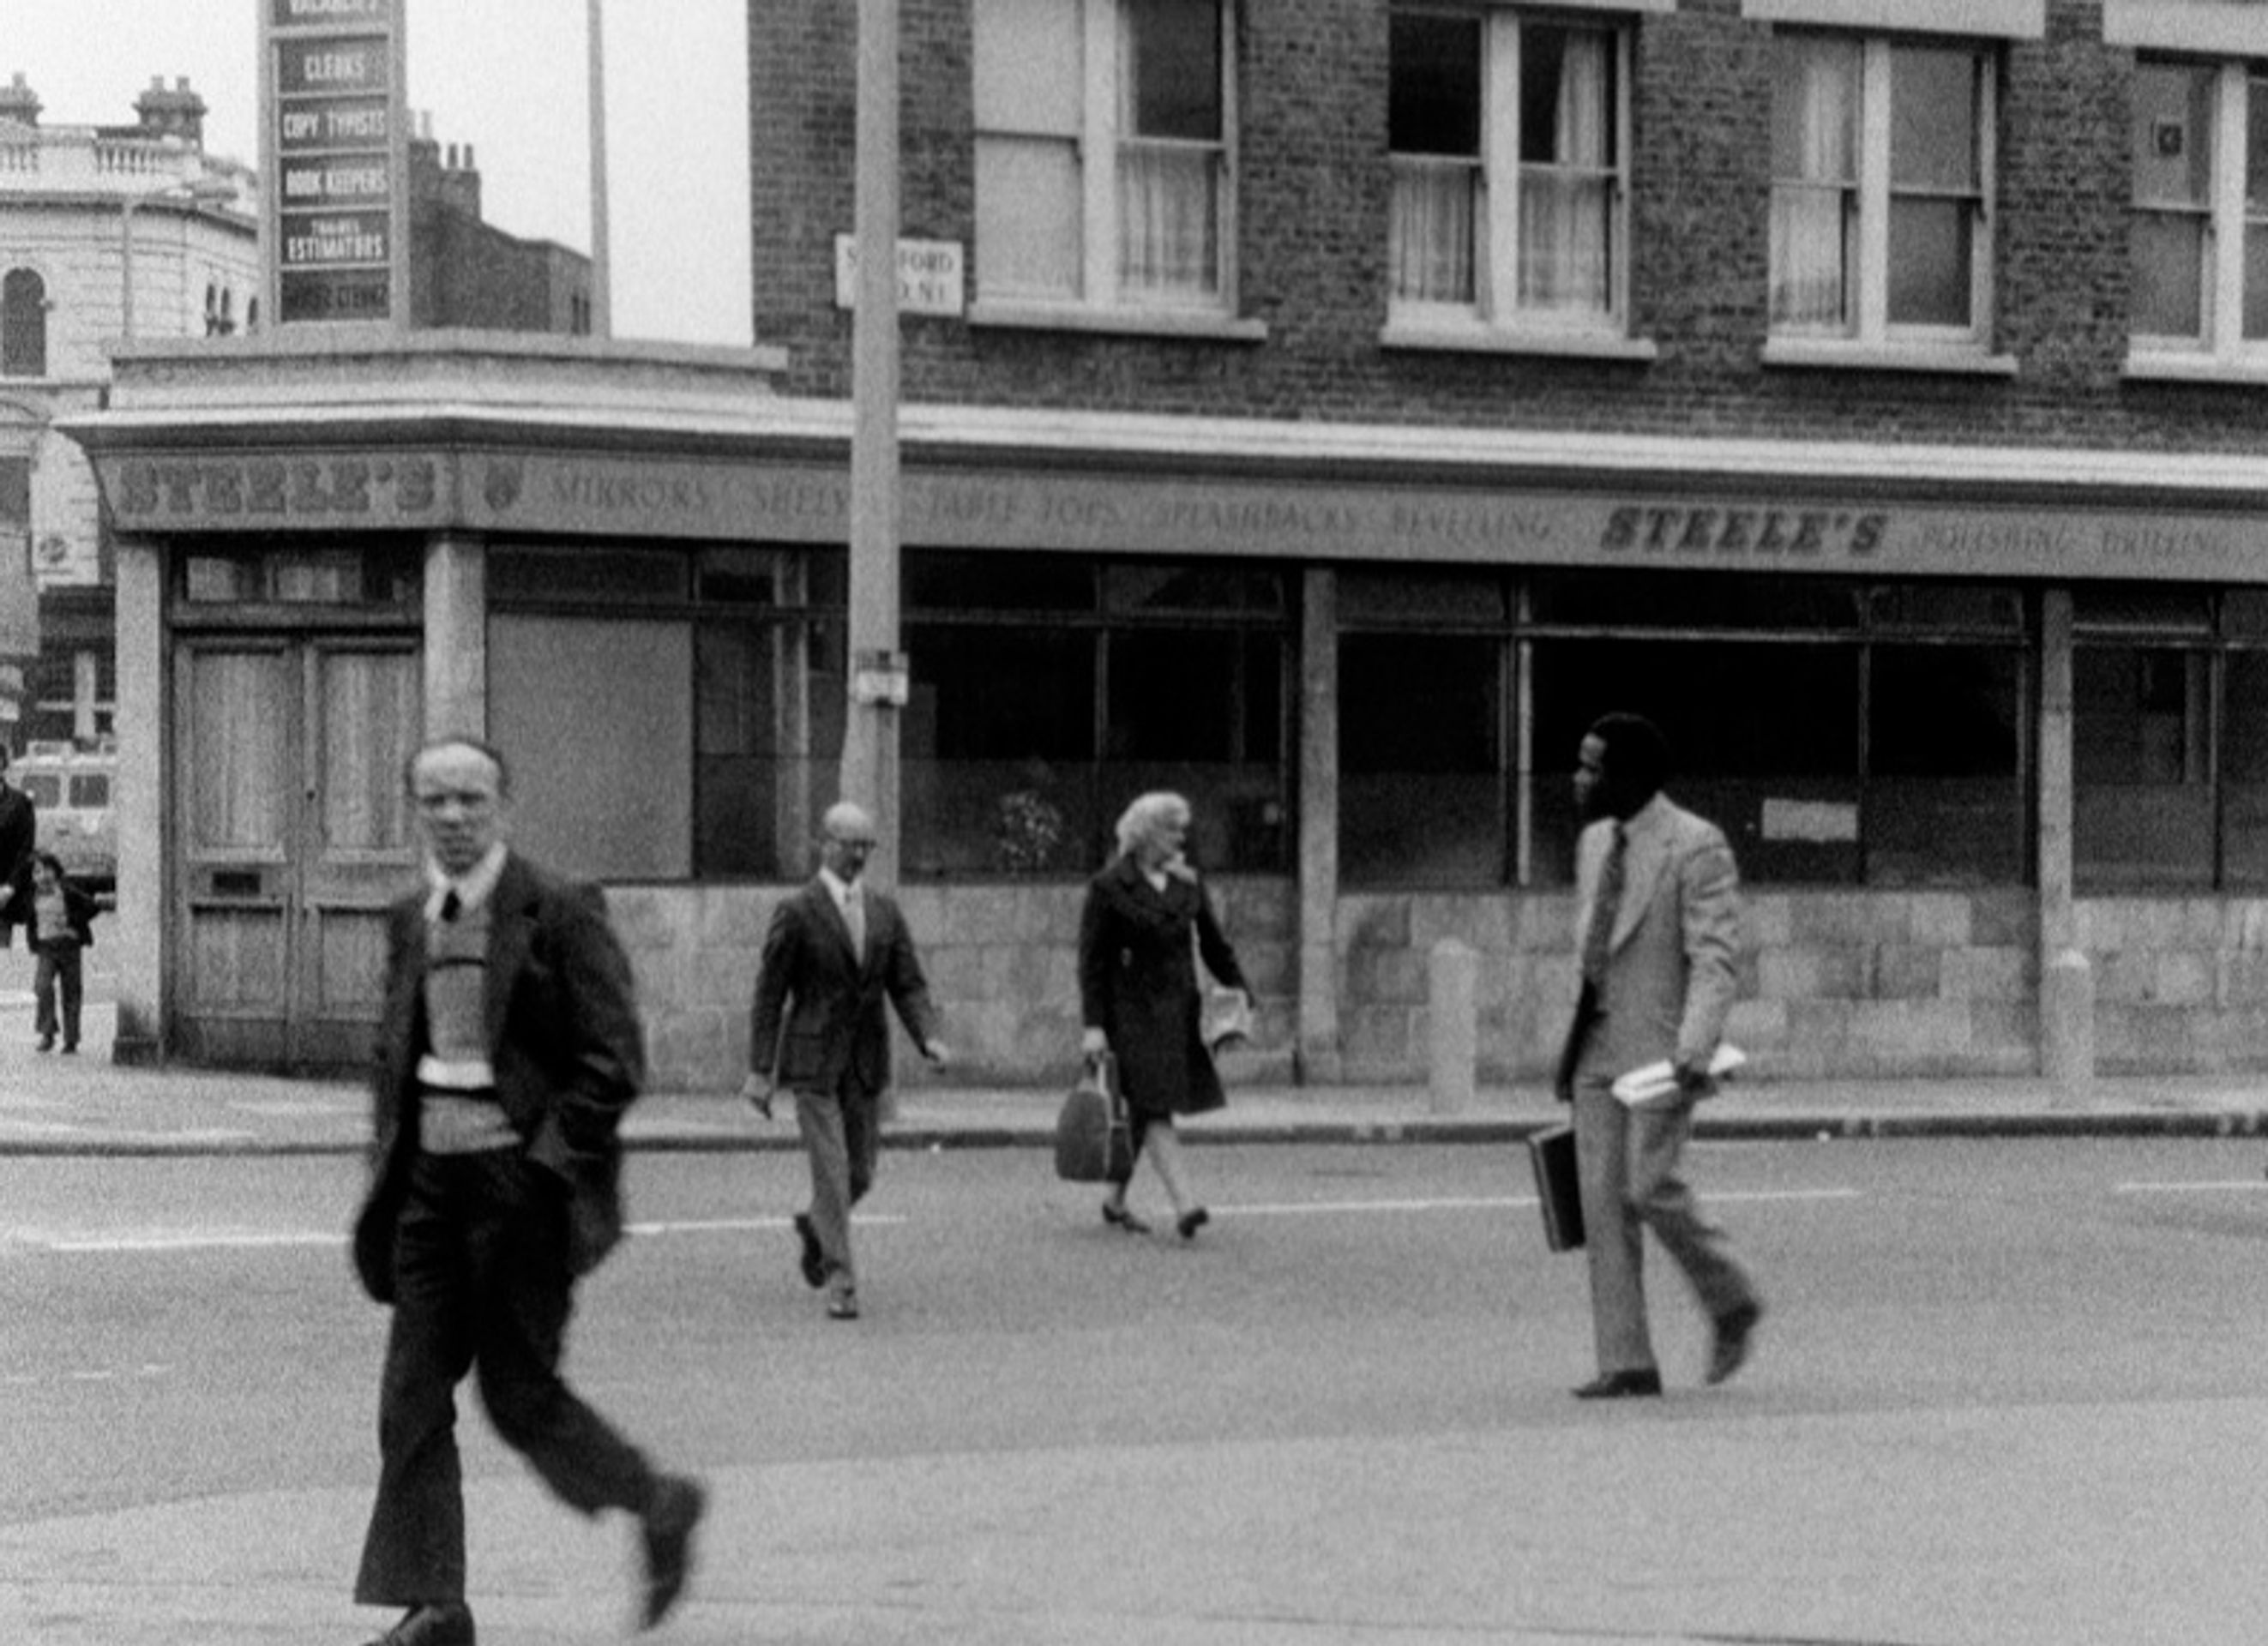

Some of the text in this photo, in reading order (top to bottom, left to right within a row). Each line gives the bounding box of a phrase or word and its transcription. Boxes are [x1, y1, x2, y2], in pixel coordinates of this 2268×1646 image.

[304, 54, 365, 81] CLERKS
[283, 113, 319, 139] COPY
[1600, 508, 1886, 556] STEELE'S
